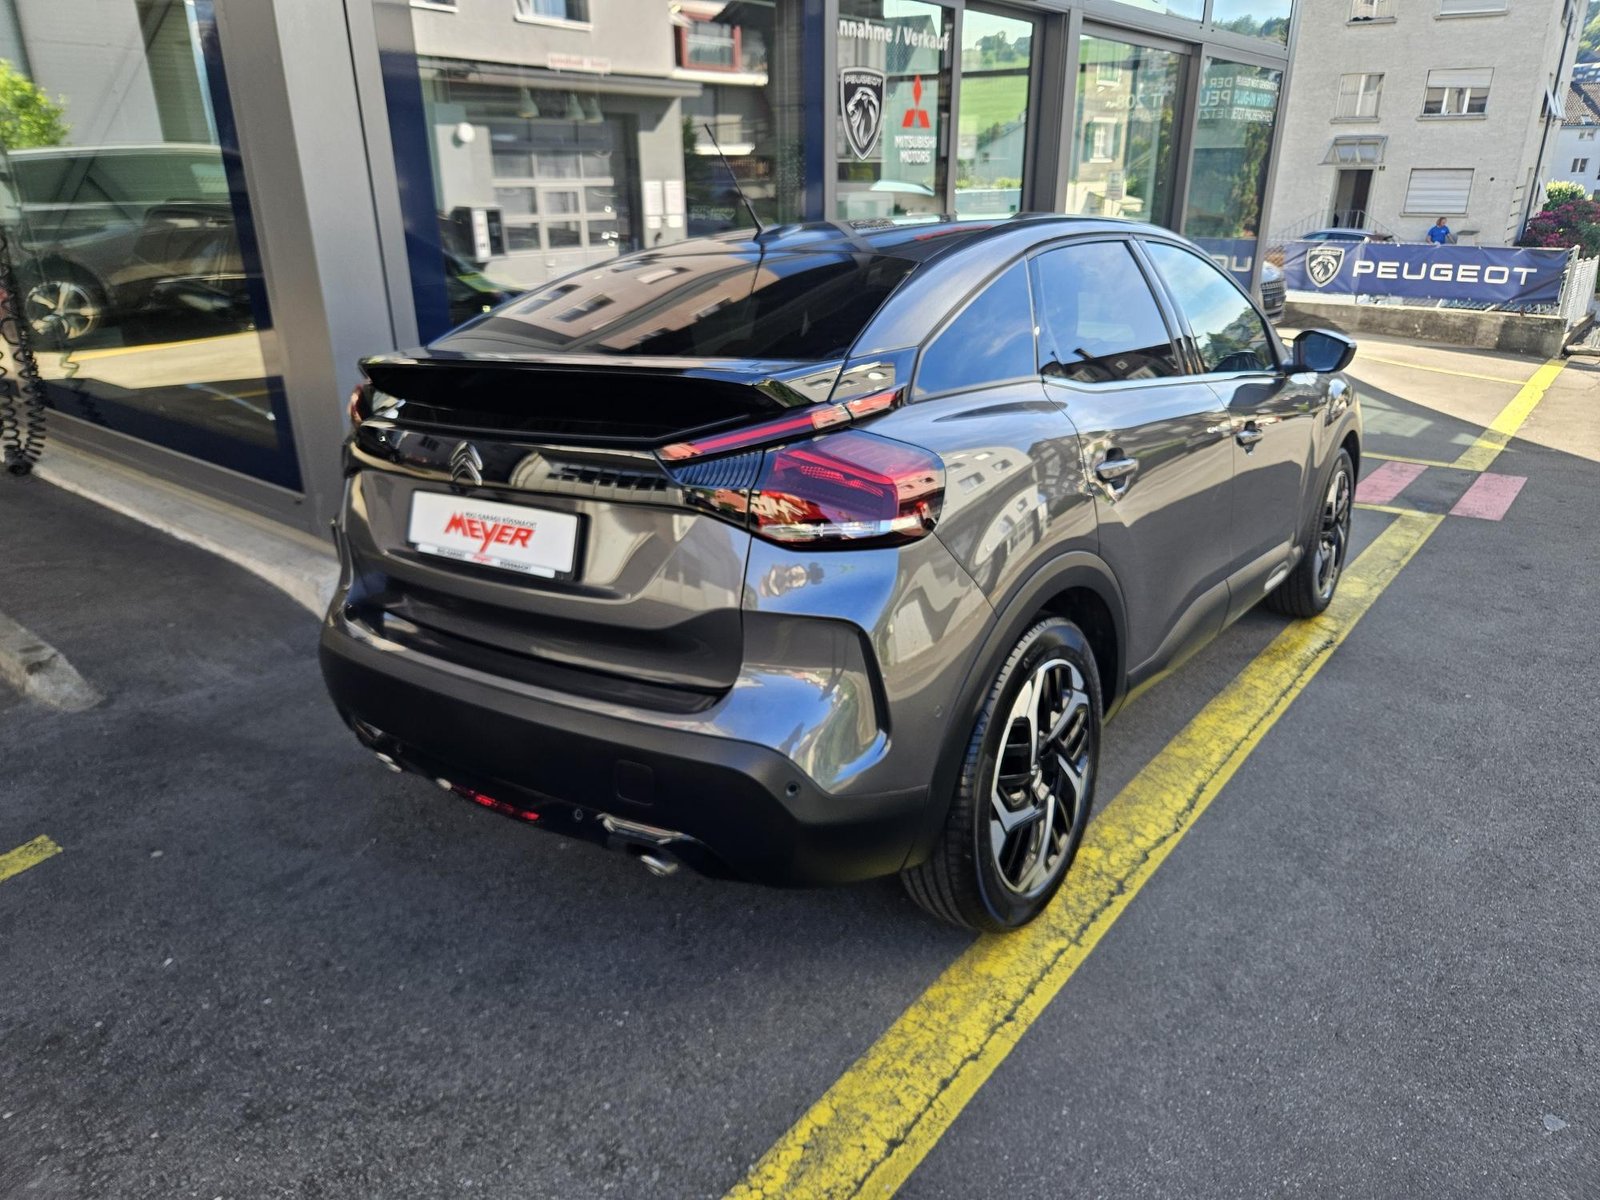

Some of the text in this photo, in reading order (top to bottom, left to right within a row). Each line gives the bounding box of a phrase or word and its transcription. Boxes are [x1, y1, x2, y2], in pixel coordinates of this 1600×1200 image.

[838, 18, 893, 43] nnahme
[903, 27, 949, 50] Verkauf
[844, 74, 883, 87] PEUGEOT
[894, 135, 937, 148] MITSUBISHI
[900, 151, 930, 163] MOTORS
[1352, 261, 1538, 286] PEUGEOT
[444, 512, 535, 553] MEYER
